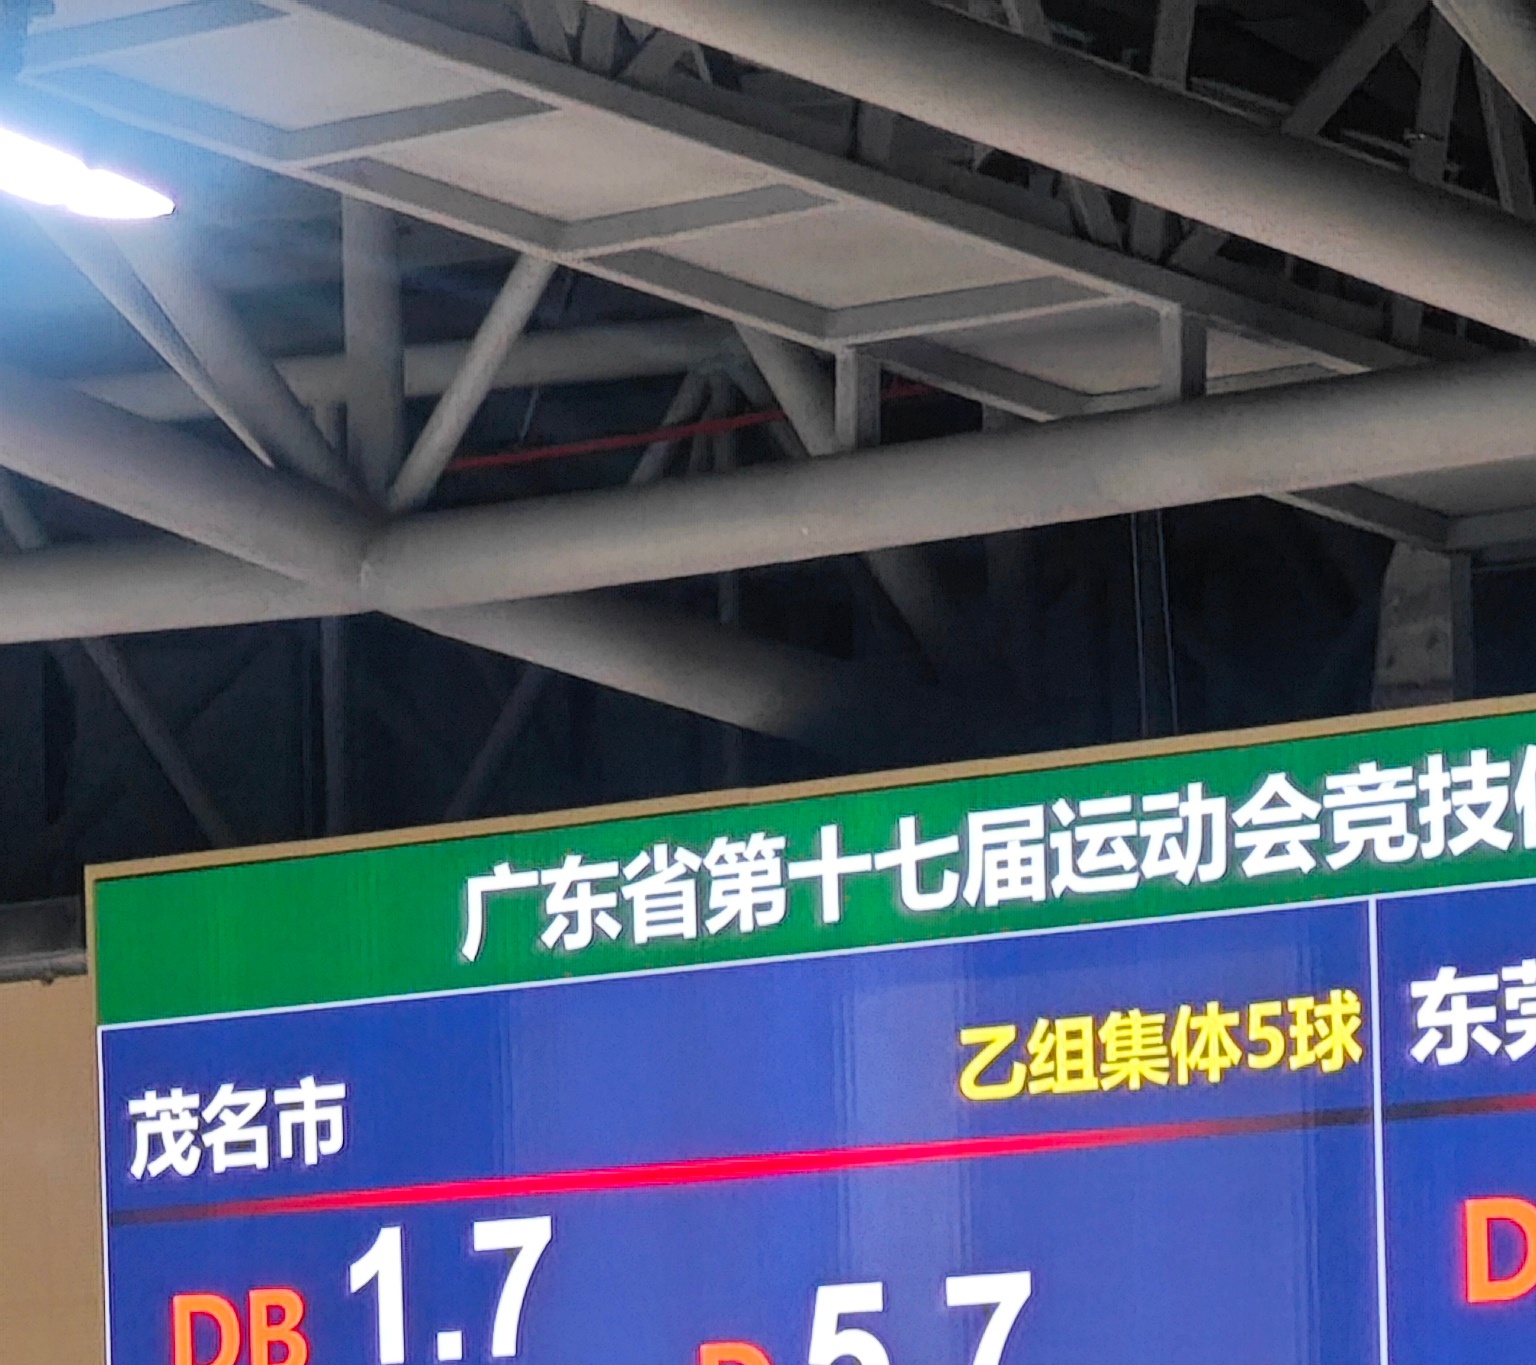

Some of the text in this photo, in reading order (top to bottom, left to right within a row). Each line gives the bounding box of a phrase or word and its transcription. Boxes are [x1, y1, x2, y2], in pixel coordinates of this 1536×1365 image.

[960, 990, 1362, 1100] 乙组集体5球
[129, 1077, 345, 1178] 茂名市
[351, 1216, 551, 1364] 1.7
